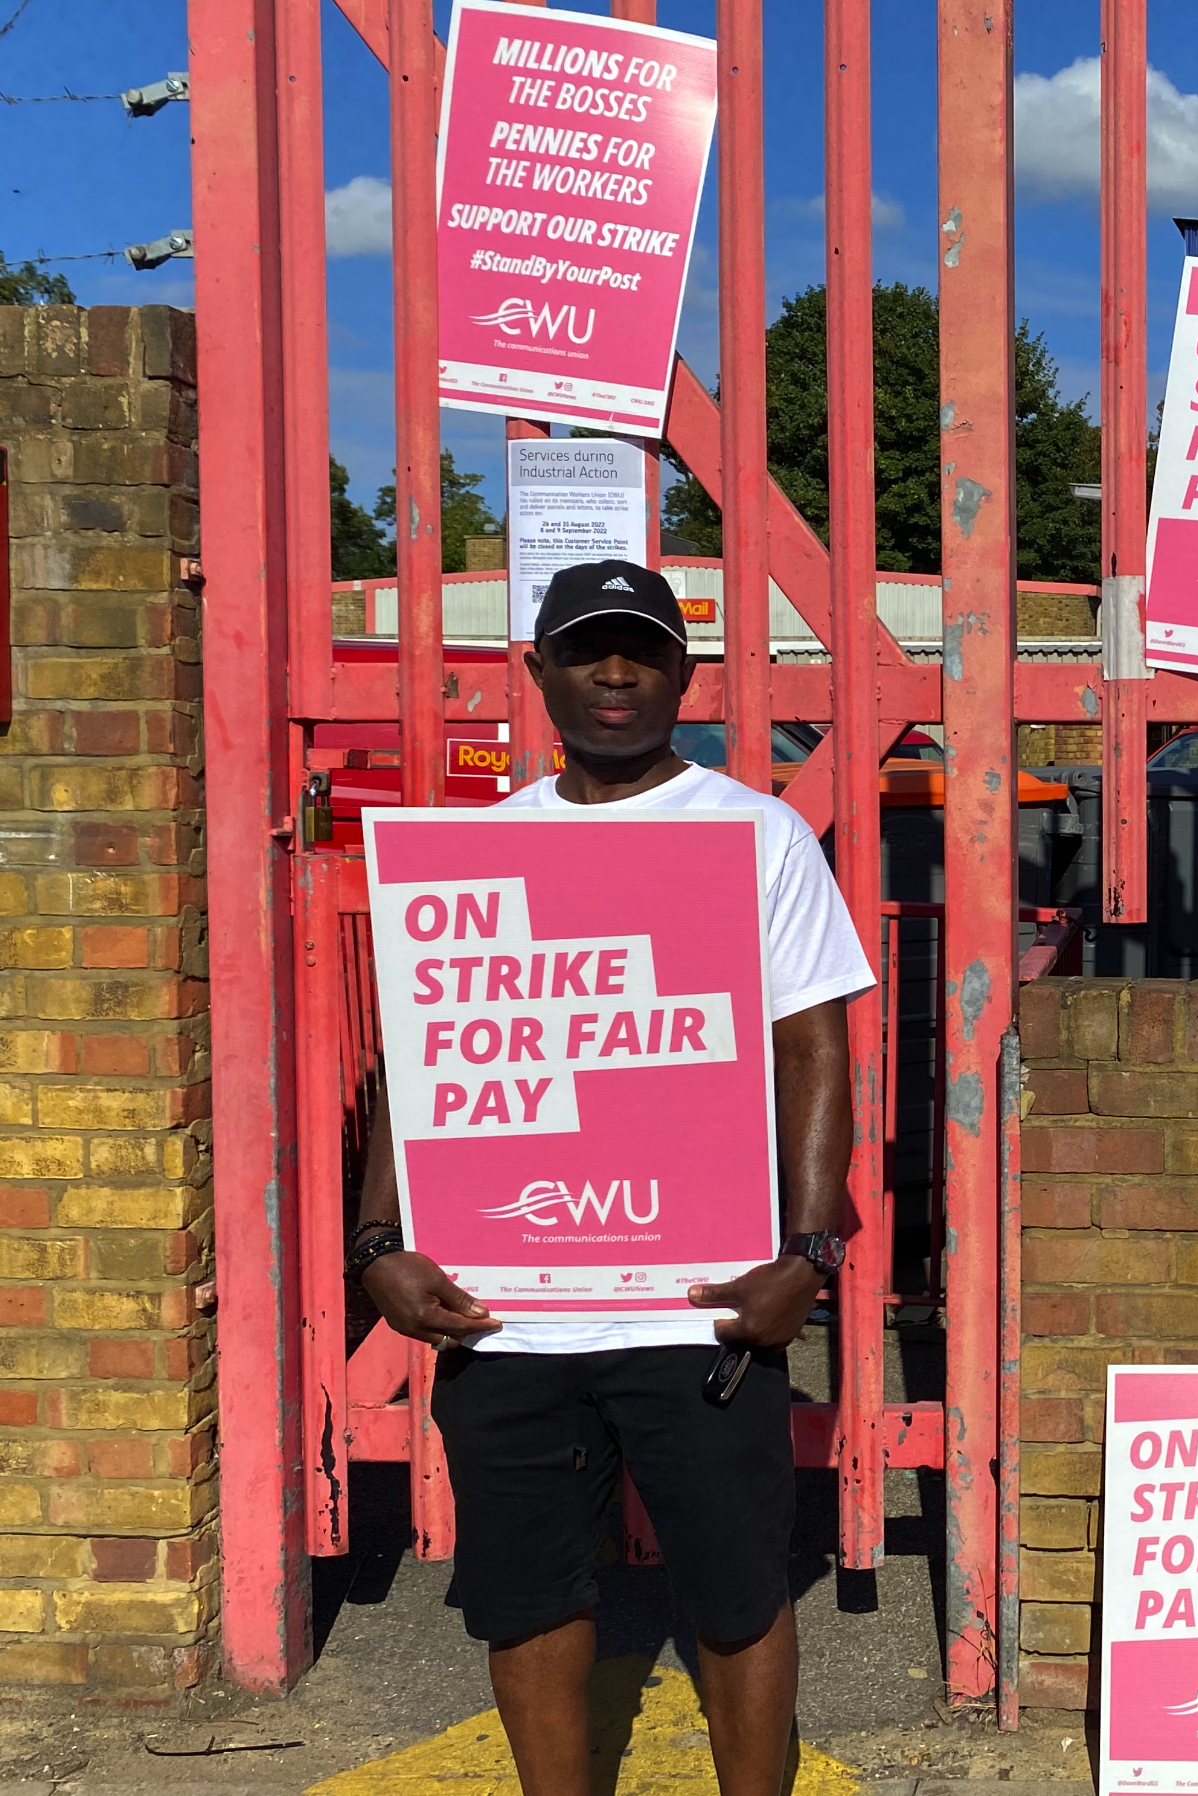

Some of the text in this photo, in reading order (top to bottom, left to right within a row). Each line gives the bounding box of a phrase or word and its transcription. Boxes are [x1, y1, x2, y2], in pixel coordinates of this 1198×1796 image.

[493, 38, 677, 91] MILLIONS FOR
[509, 76, 652, 122] THE BOSSES
[490, 121, 655, 170] PENNIES FOR
[486, 158, 652, 205] THE WORKERS
[448, 204, 679, 256] SUPPORT OUR STRIKE
[471, 250, 641, 290] #StandByYourPost
[494, 298, 595, 343] CWU
[493, 339, 590, 359] The communications union
[520, 449, 614, 464] Services during
[520, 466, 618, 479] Industrial Action
[602, 584, 634, 592] adidas
[679, 602, 708, 615] Mail
[459, 745, 509, 772] Roy
[405, 892, 500, 942] ON
[414, 949, 628, 1005] STRIKE
[424, 1008, 707, 1066] FOR FAIR
[433, 1078, 553, 1126] PAY
[519, 1180, 659, 1225] CWU
[521, 1233, 662, 1243] The communications union
